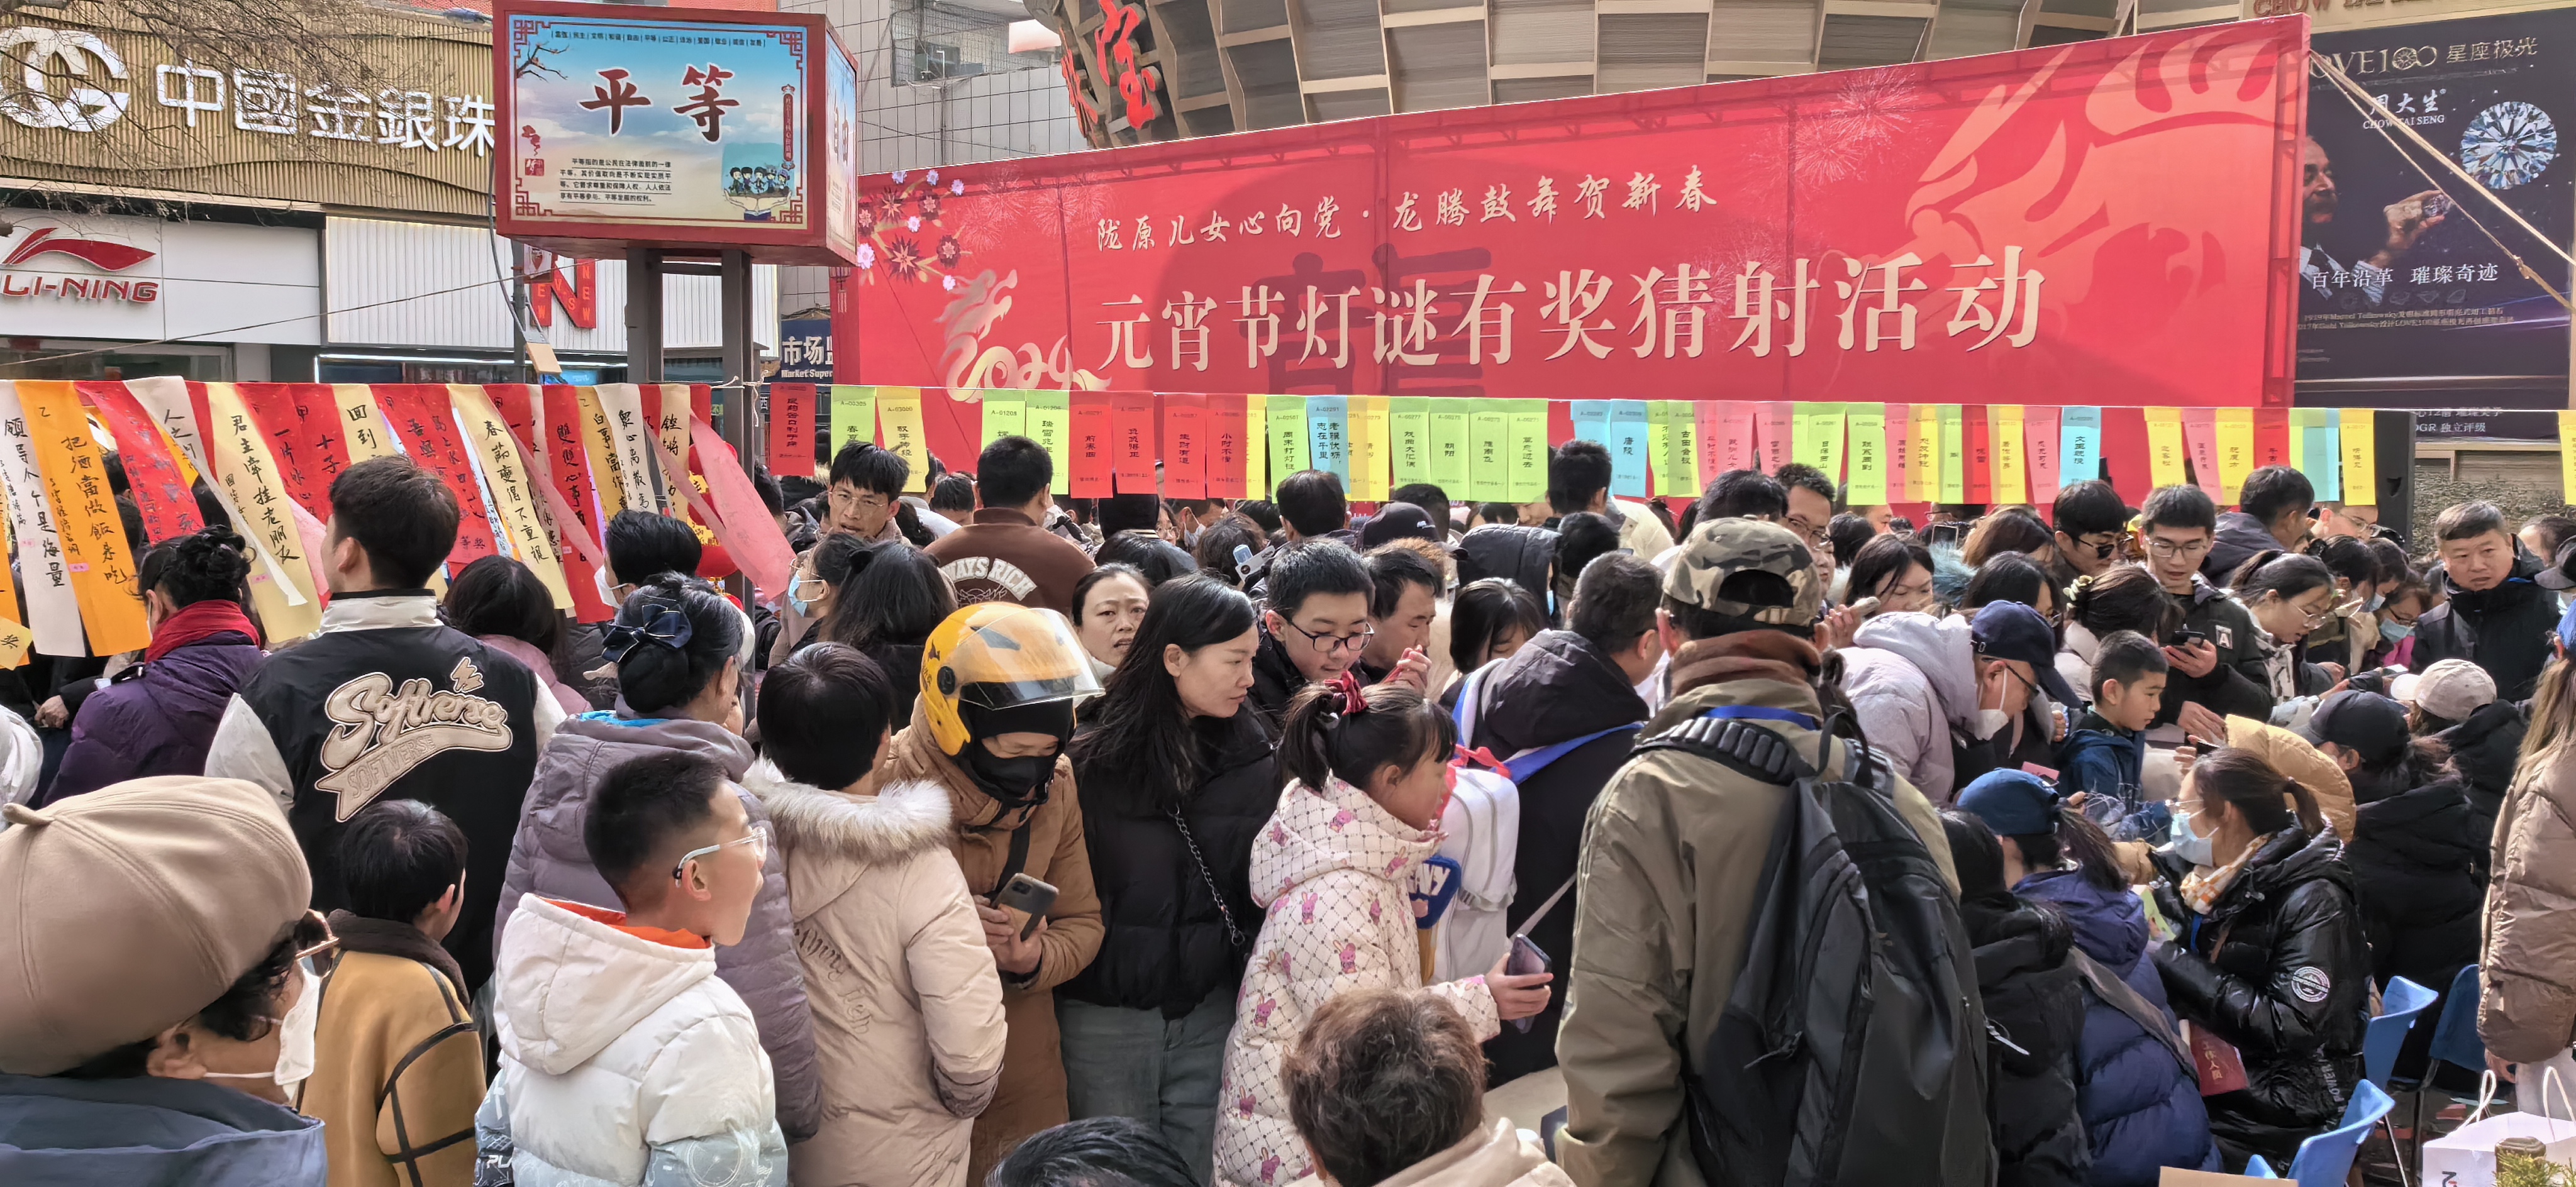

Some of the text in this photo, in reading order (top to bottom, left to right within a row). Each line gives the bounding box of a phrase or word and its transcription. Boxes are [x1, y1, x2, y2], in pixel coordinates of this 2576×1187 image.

[2446, 36, 2538, 65] 星座极光
[157, 58, 495, 157] 中國金銀珠
[579, 65, 740, 143] 平等
[2369, 88, 2439, 116] 周大生
[2363, 114, 2445, 130] CHOW TAI SENG
[3, 274, 159, 303] LI-NING
[2312, 263, 2499, 289] 百年沿革 璀璨奇迹
[1095, 245, 2045, 373] 元宵节灯谜有奖猜射活动
[781, 368, 809, 378] Market
[1085, 434, 1096, 458] 前奏曲
[1179, 434, 1191, 465] 生财有道
[1404, 431, 1416, 468] 戏曲大汇演
[1444, 443, 1455, 457] 朝阳
[1681, 431, 1692, 465] 古田会议
[987, 558, 1038, 601] RICH
[347, 734, 436, 799] SOFTVERSE
